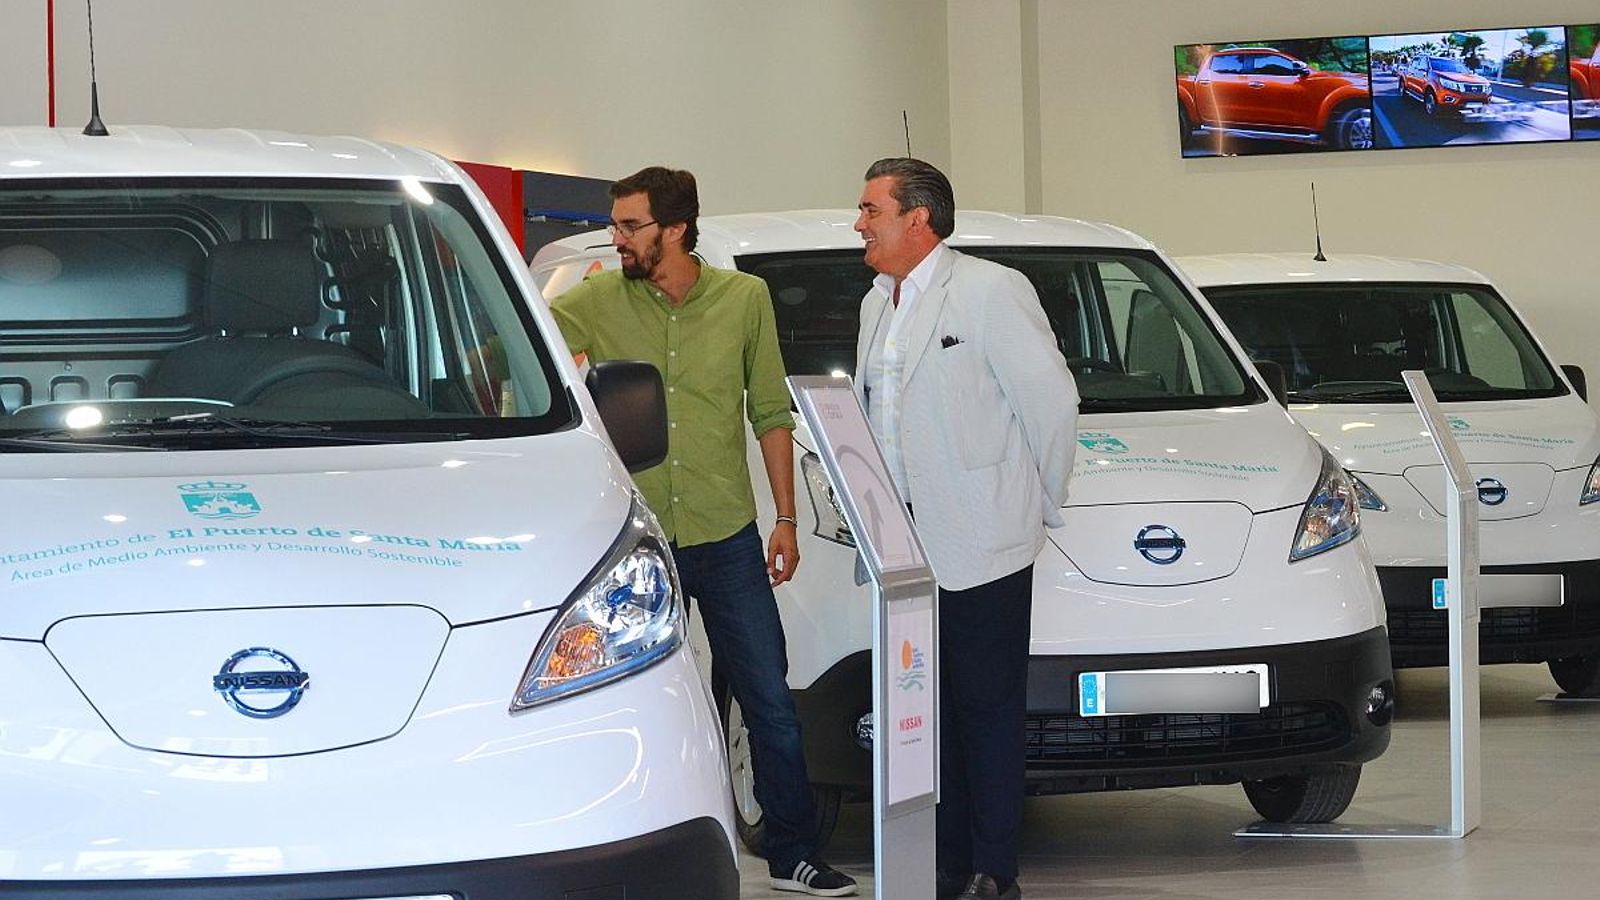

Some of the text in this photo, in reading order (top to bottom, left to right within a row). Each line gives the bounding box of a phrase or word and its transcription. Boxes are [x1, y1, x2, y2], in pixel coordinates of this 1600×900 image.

[128, 533, 157, 544] de
[168, 528, 195, 540] El
[203, 526, 298, 537] Puerto
[307, 527, 342, 538] de
[59, 561, 83, 575] de
[88, 552, 148, 568] Medio
[154, 543, 247, 557] Ambiente
[252, 543, 262, 552] y
[268, 541, 362, 556] Desarrollo
[367, 548, 464, 568] Sostenible
[223, 674, 301, 688] NISSAN
[1087, 698, 1094, 708] E
